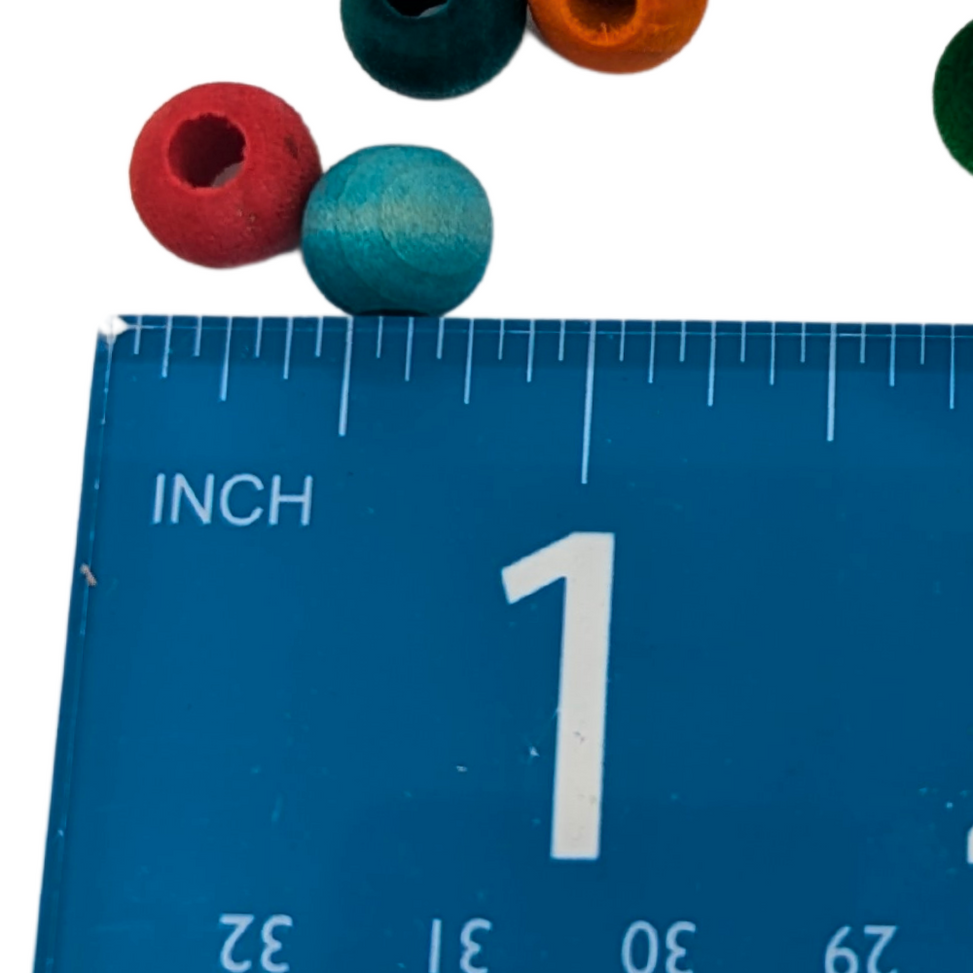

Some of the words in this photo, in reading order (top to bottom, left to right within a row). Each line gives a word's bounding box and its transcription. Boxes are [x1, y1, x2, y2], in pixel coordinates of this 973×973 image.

[154, 475, 313, 525] INCH
[502, 532, 615, 860] 1
[220, 914, 292, 973] 32
[430, 917, 491, 973] 31
[623, 920, 696, 973] 30
[826, 924, 895, 973] 29
